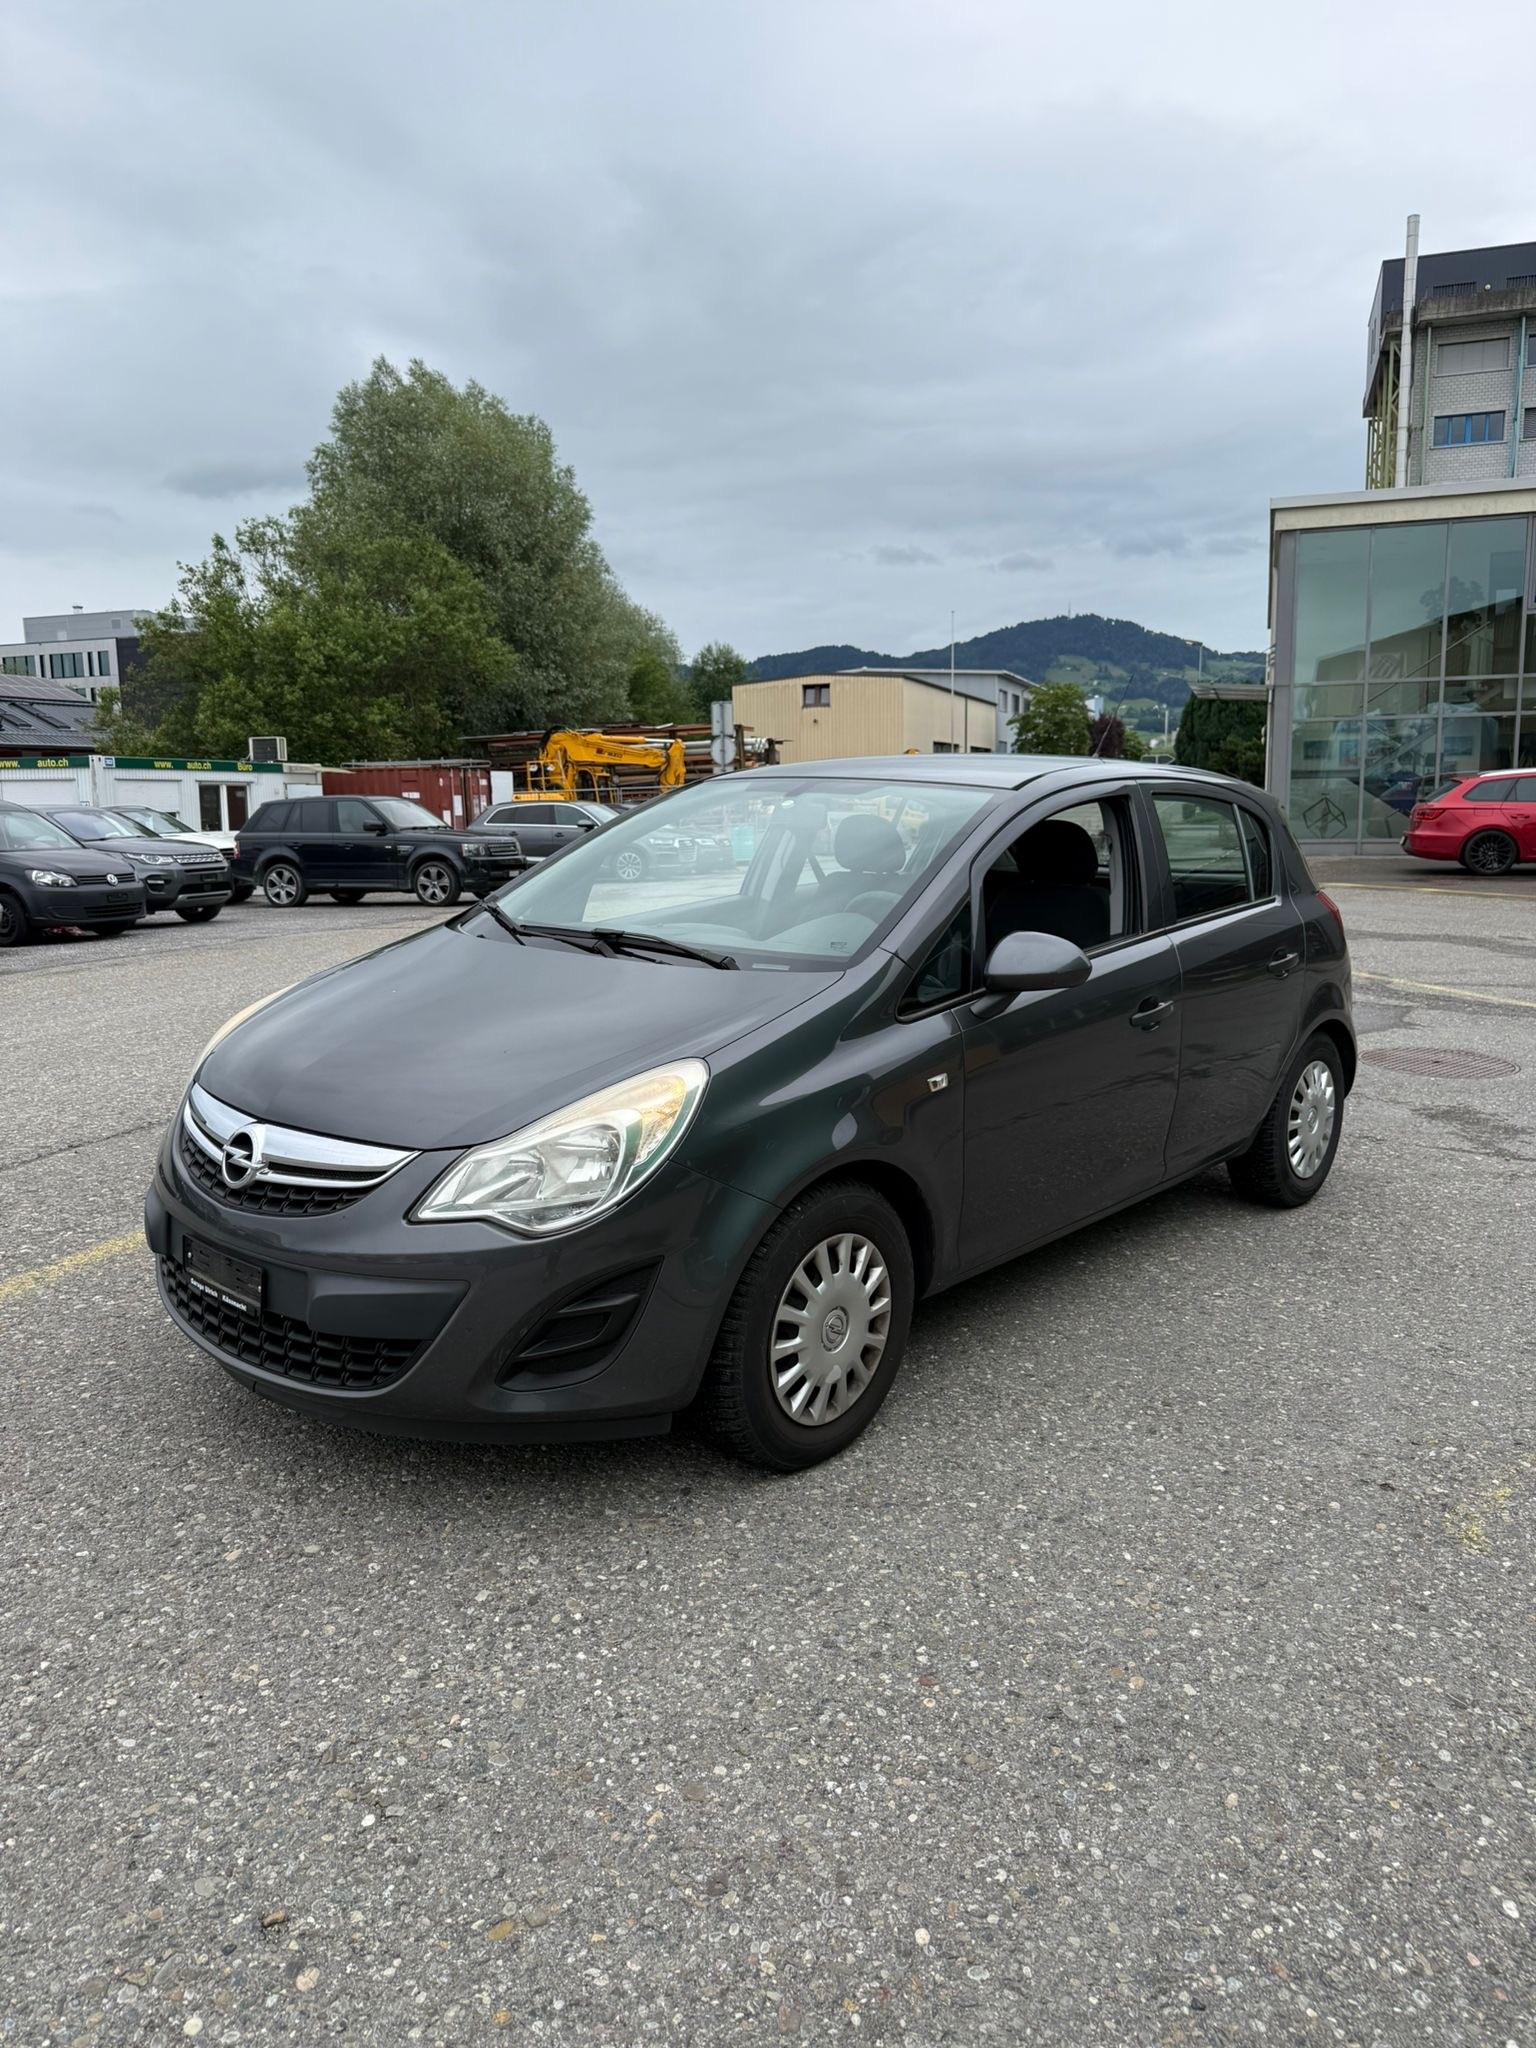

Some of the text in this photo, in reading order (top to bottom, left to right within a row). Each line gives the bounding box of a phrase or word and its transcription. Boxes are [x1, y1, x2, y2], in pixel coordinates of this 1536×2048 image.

[37, 758, 69, 768] auto.ch
[154, 761, 174, 769] www.
[186, 761, 212, 770] auto.ch
